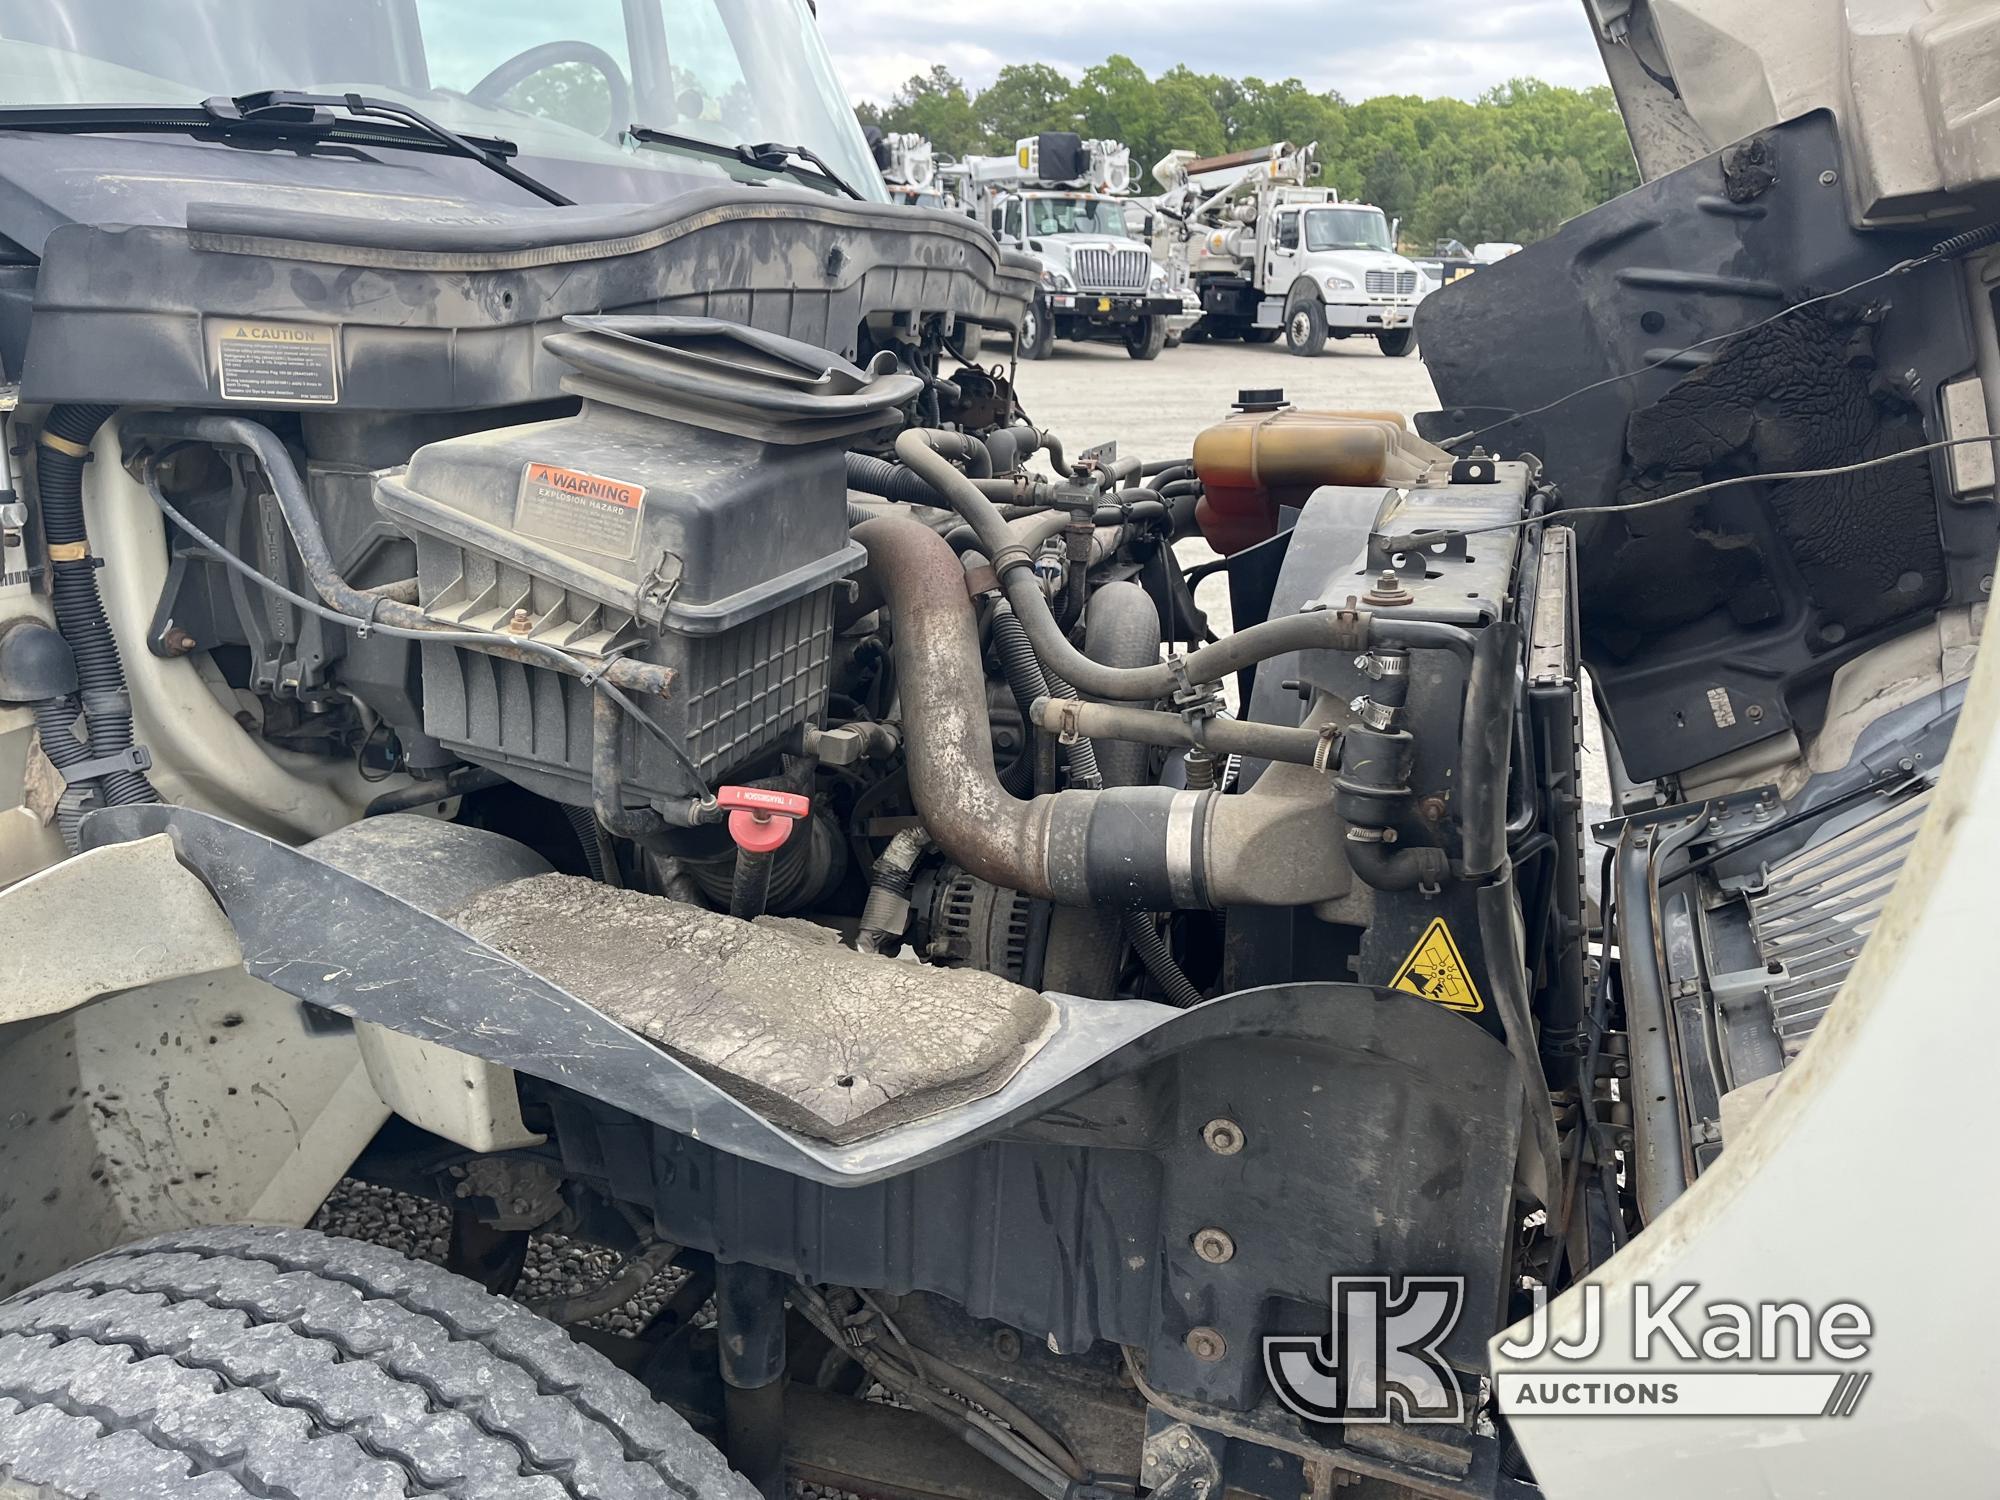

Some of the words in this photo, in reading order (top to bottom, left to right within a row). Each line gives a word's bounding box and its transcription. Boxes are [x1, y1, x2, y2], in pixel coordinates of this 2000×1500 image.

[251, 328, 315, 341] CAUTION
[538, 487, 586, 507] EXPLOSION
[589, 501, 624, 515] HAZARD
[553, 472, 629, 503] WARNING
